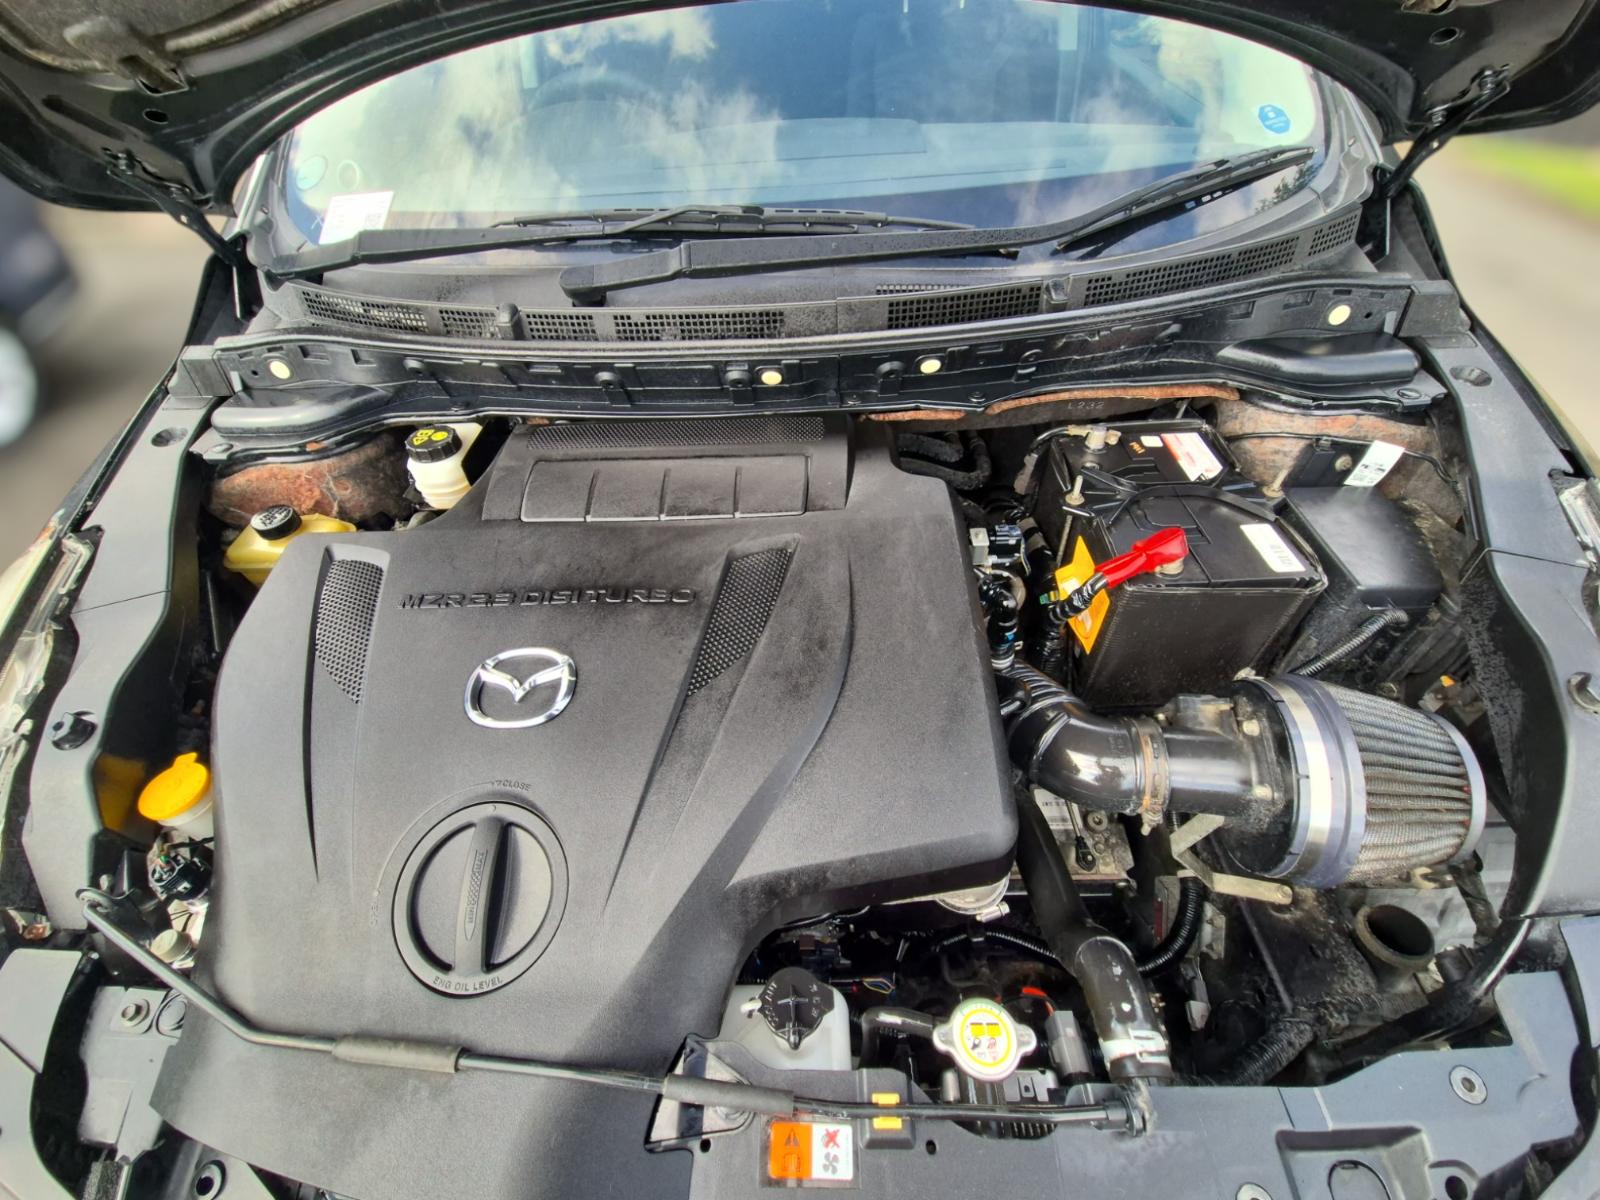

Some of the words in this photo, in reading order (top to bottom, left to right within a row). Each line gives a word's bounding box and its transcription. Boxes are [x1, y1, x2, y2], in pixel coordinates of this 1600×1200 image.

[585, 586, 698, 604] TURBO
[502, 778, 532, 792] CLOSE
[433, 975, 452, 989] ENG
[454, 982, 470, 992] OIL
[472, 975, 503, 992] LEVEL
